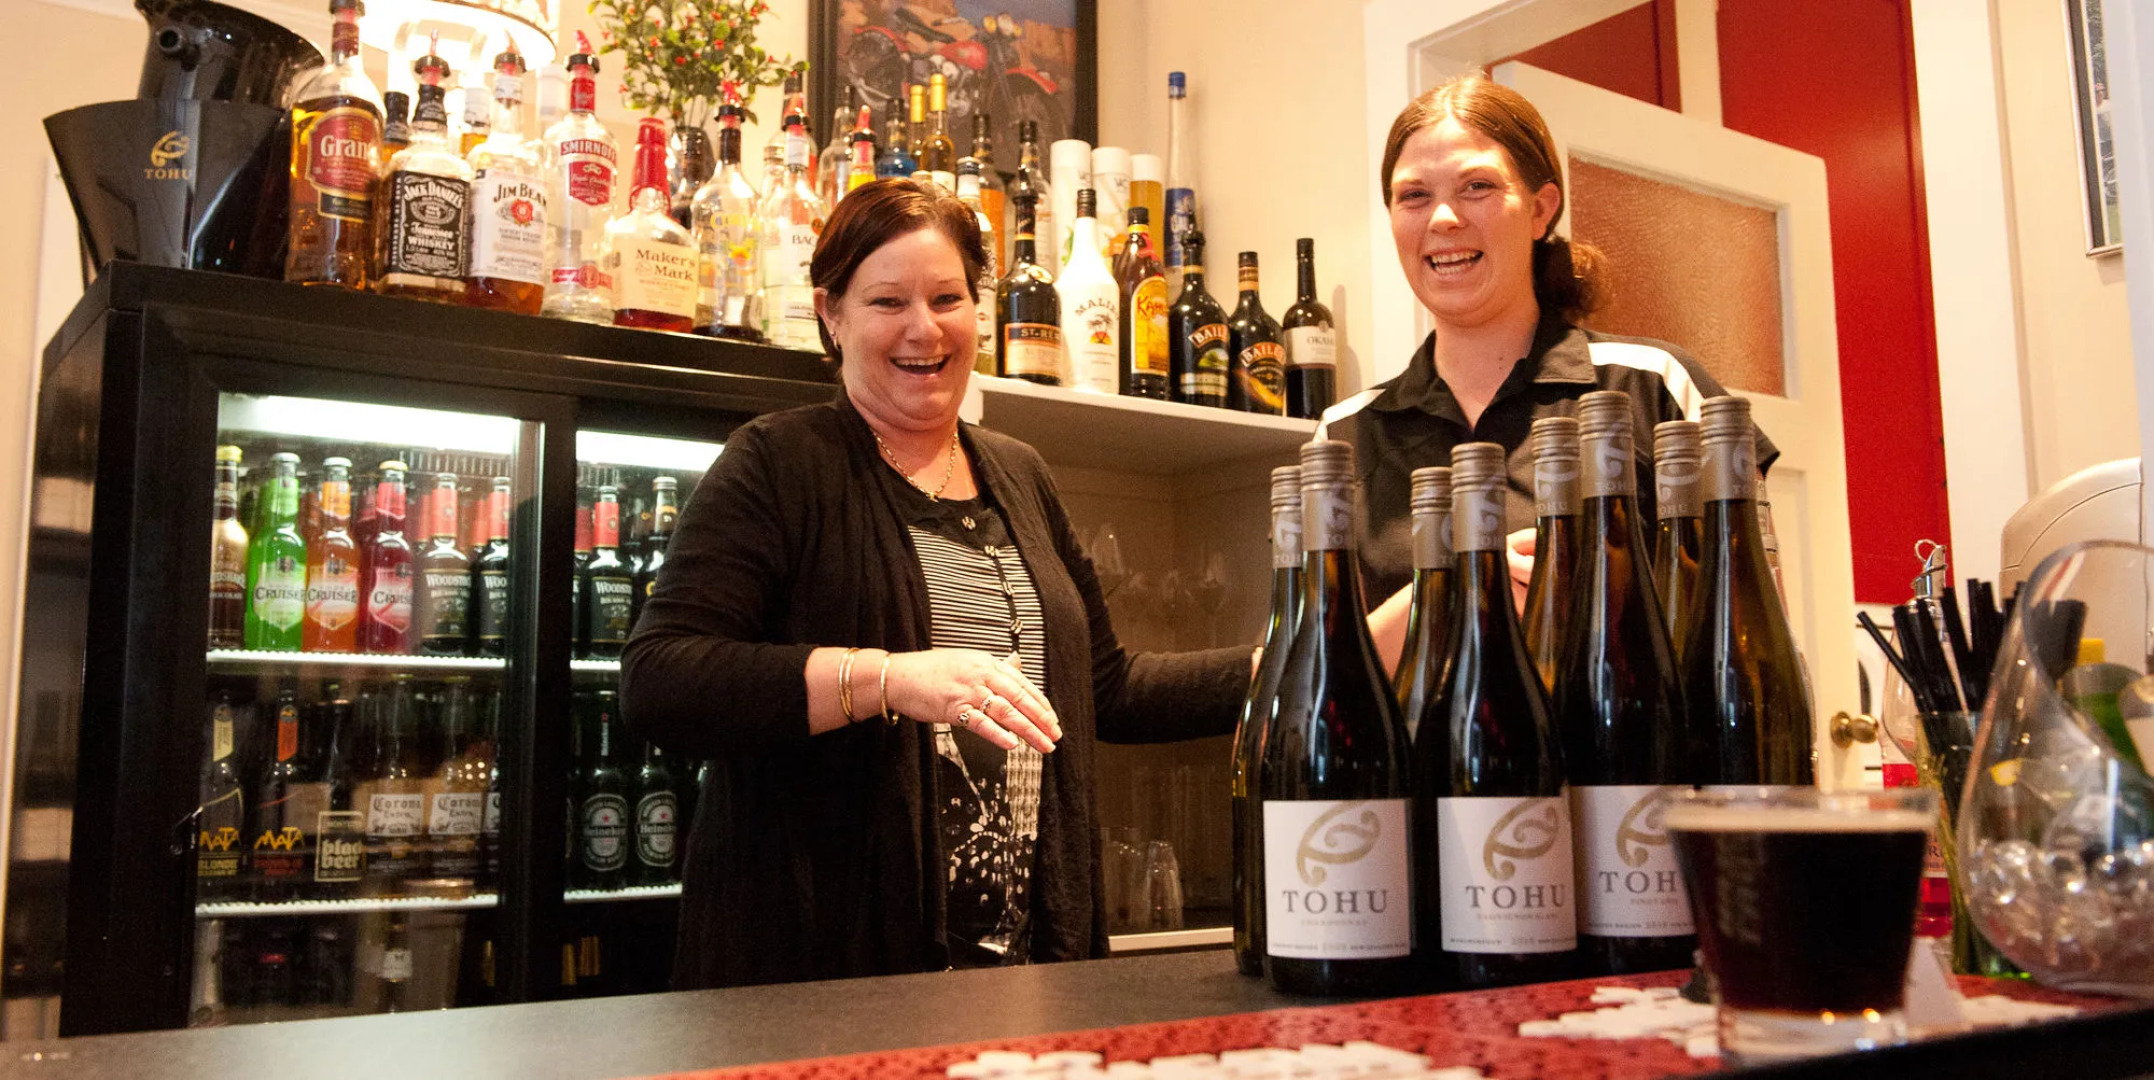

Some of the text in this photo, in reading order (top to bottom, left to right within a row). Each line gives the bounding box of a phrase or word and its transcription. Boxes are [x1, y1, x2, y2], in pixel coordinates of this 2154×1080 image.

[320, 134, 374, 160] Gran
[143, 168, 193, 181] TOHU
[403, 183, 429, 201] JACK
[492, 183, 517, 203] JIM
[407, 236, 456, 251] WHISKEY
[635, 248, 697, 268] Maker's
[653, 264, 694, 283] Mark
[253, 826, 305, 851] MATA
[321, 854, 360, 869] beer
[1599, 870, 1679, 894] TOH
[1282, 888, 1390, 915] TOHU
[1465, 884, 1567, 910] TOHU
